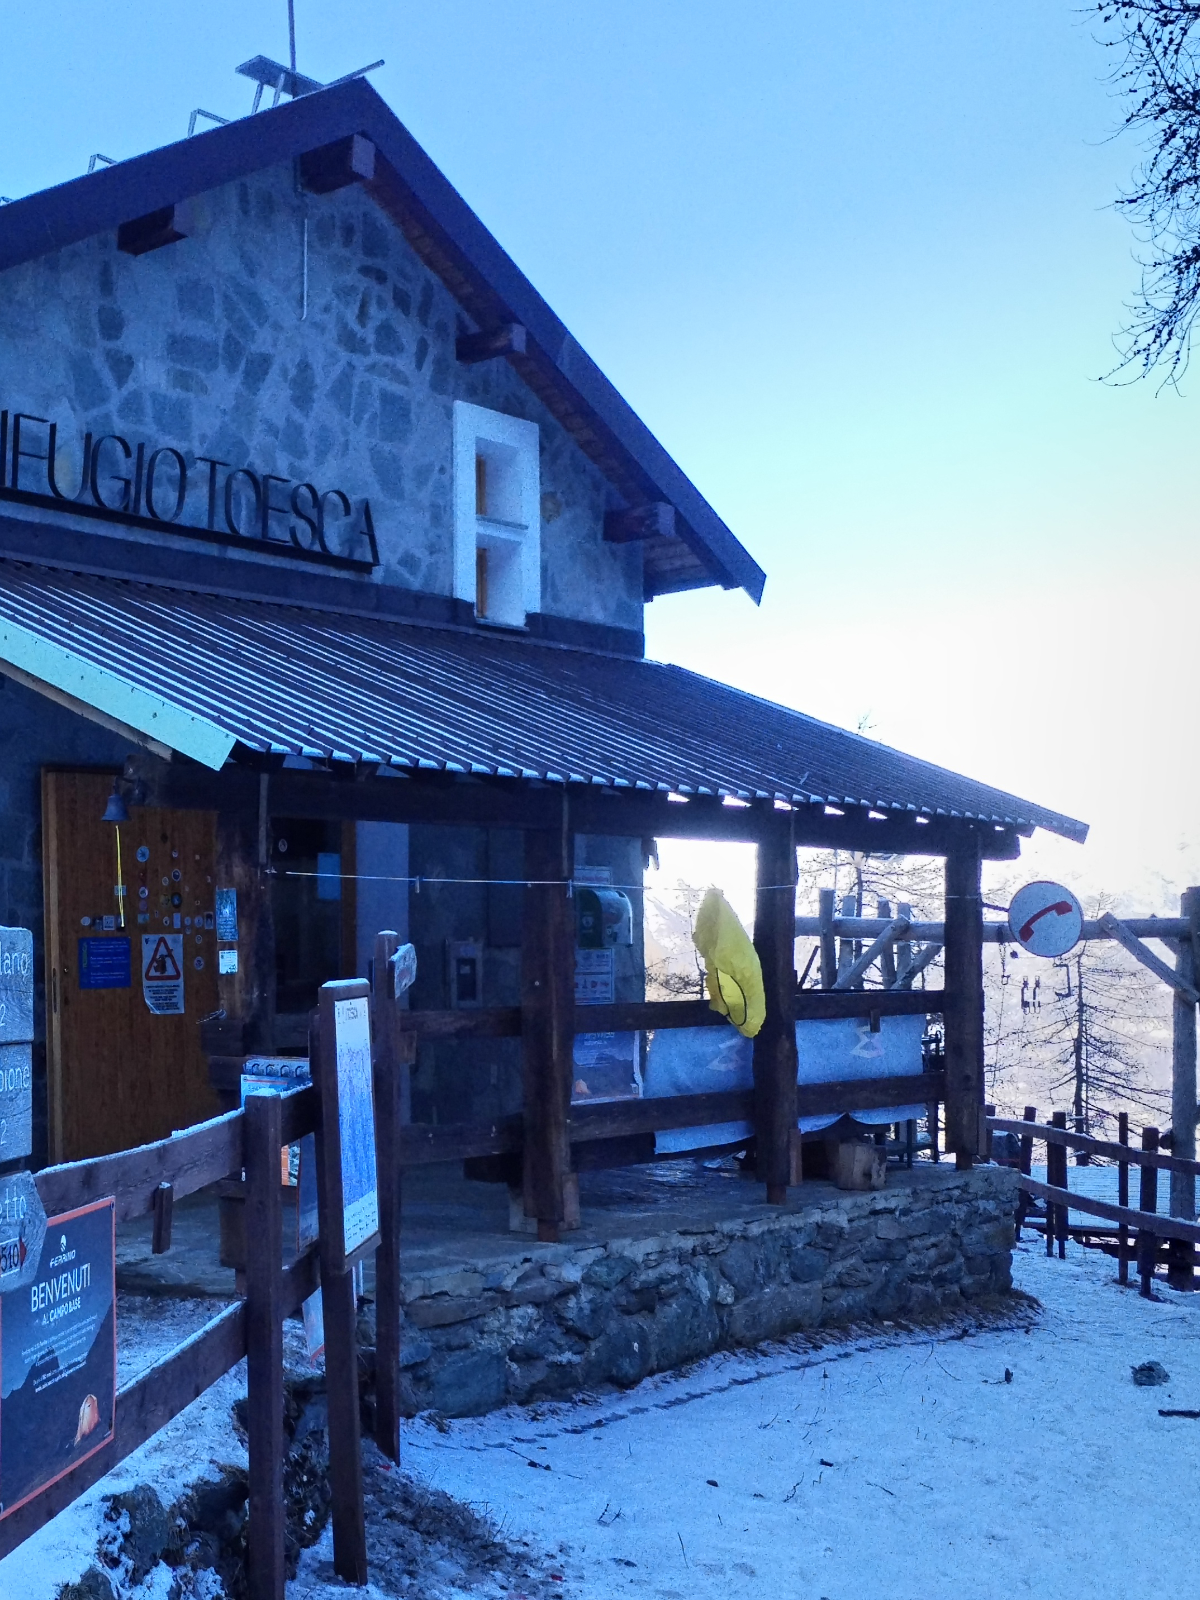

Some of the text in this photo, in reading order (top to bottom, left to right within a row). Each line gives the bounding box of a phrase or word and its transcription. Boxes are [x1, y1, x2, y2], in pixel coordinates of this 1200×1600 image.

[194, 456, 382, 567] TOESCA
[0, 1003, 6, 1026] 2
[0, 1119, 8, 1144] 2
[0, 1243, 20, 1273] 510
[30, 1262, 91, 1313] BENVENUTI
[50, 1303, 68, 1324] CAMPO
[68, 1296, 81, 1313] BASE
